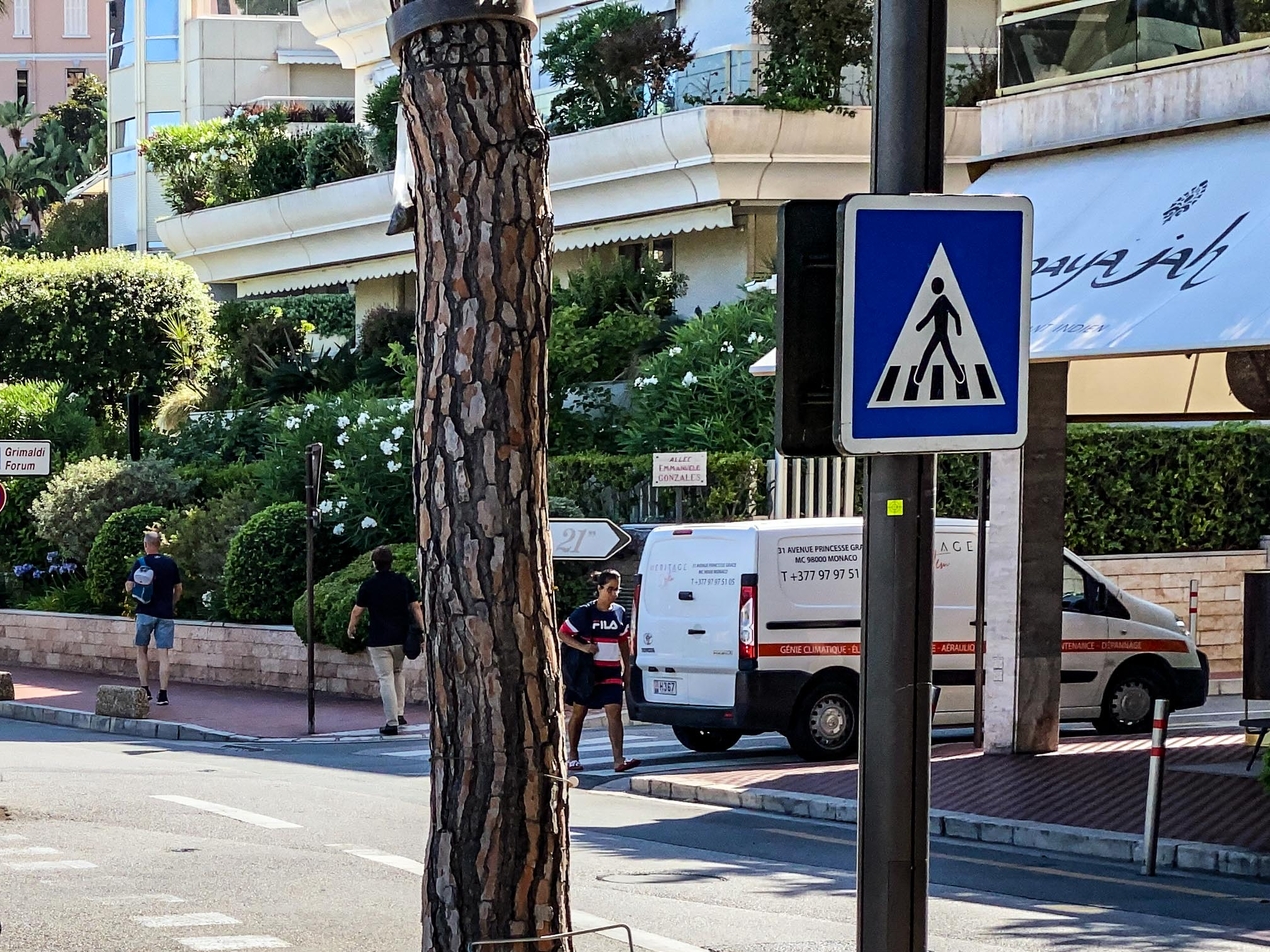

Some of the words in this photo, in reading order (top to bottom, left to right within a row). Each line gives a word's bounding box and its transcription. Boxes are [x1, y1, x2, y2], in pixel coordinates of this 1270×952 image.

[5, 447, 46, 457] Grimaldi
[5, 461, 36, 470] Forum
[787, 545, 813, 554] AVENUE
[815, 544, 849, 553] PRINCESSE
[828, 554, 858, 562] MONACO
[781, 571, 788, 582] T
[790, 570, 816, 582] +377
[818, 569, 831, 580] 97
[833, 569, 846, 580] 97
[848, 568, 860, 579] 51
[592, 620, 619, 630] FILA
[780, 644, 802, 654] GÉNIE
[803, 645, 846, 654] CLIMATIQUE
[659, 682, 675, 693] H367
